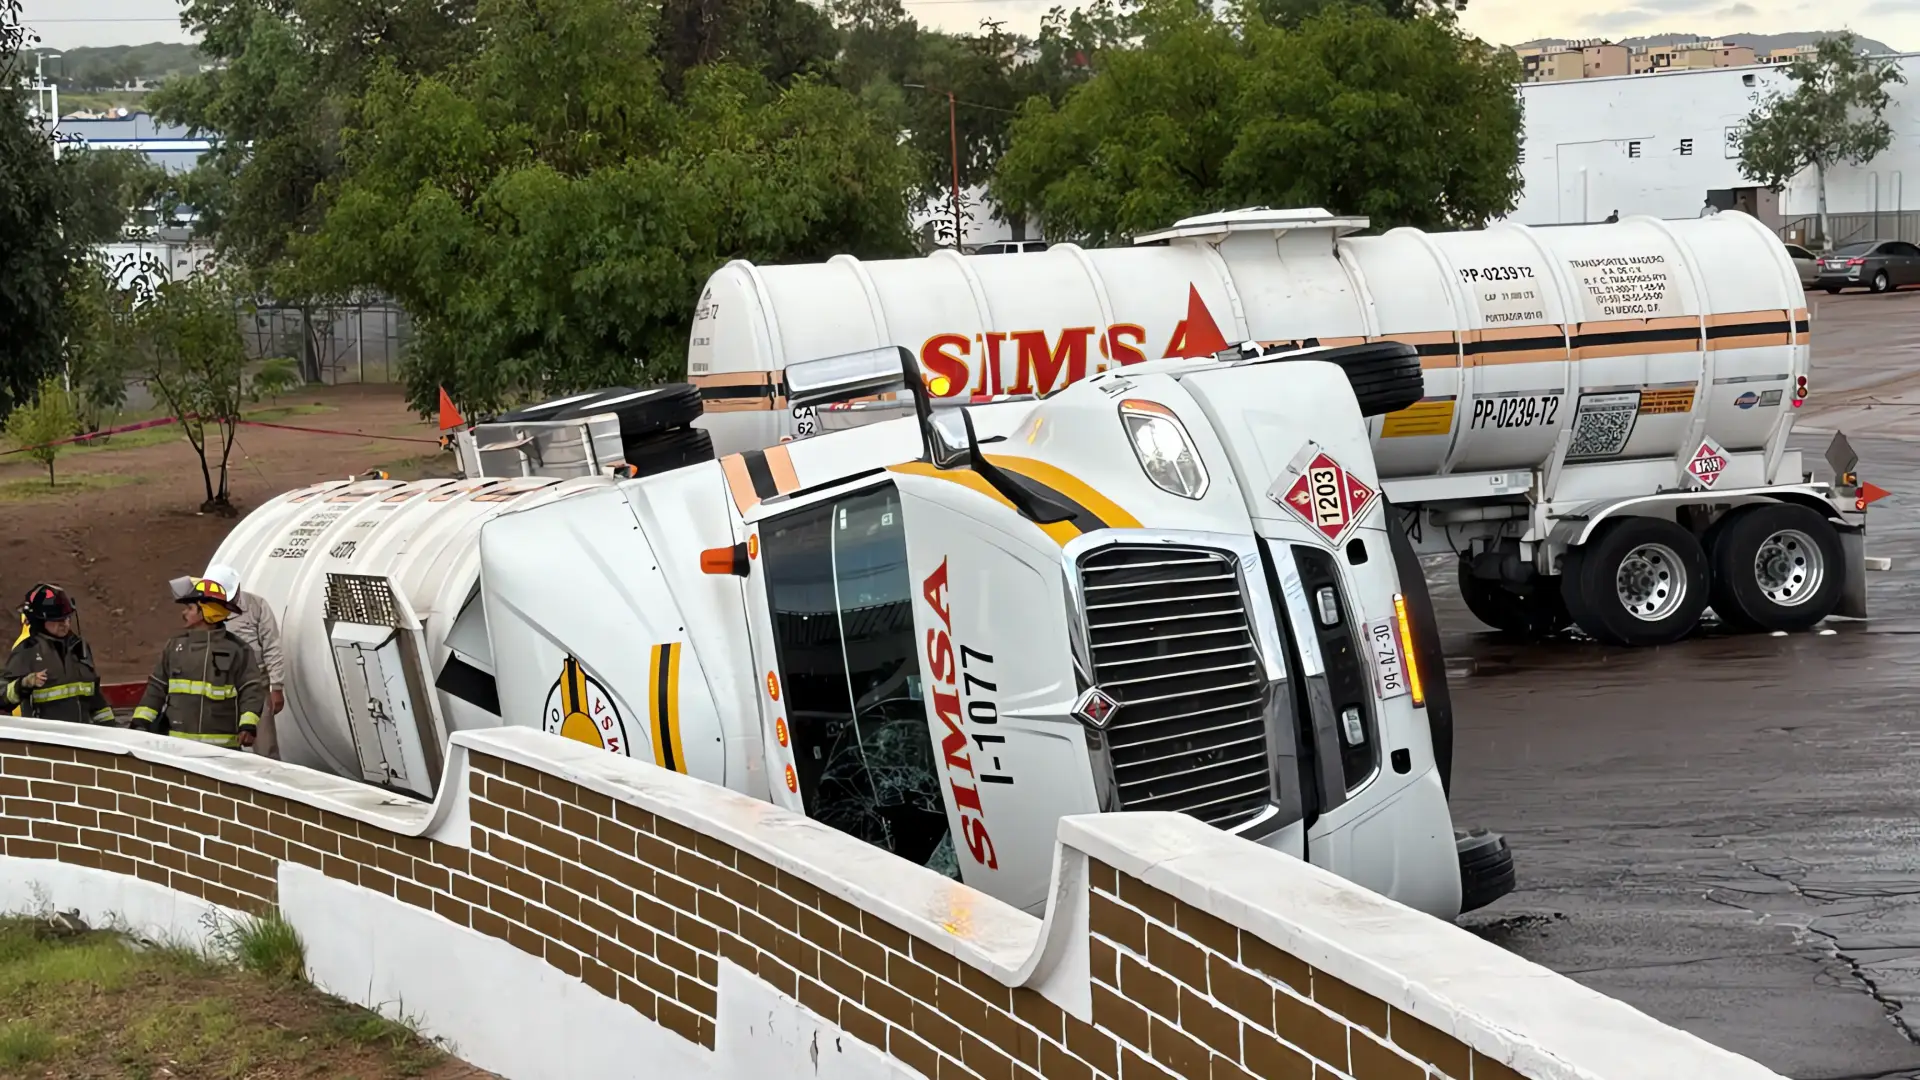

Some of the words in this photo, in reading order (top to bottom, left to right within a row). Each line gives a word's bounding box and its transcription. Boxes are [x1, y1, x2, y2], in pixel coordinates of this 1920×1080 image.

[919, 318, 1190, 398] SIMS
[1470, 396, 1559, 430] PP-0239-T2
[1314, 470, 1340, 523] 1203
[1353, 489, 1367, 499] 3
[923, 554, 999, 871] SIMSA
